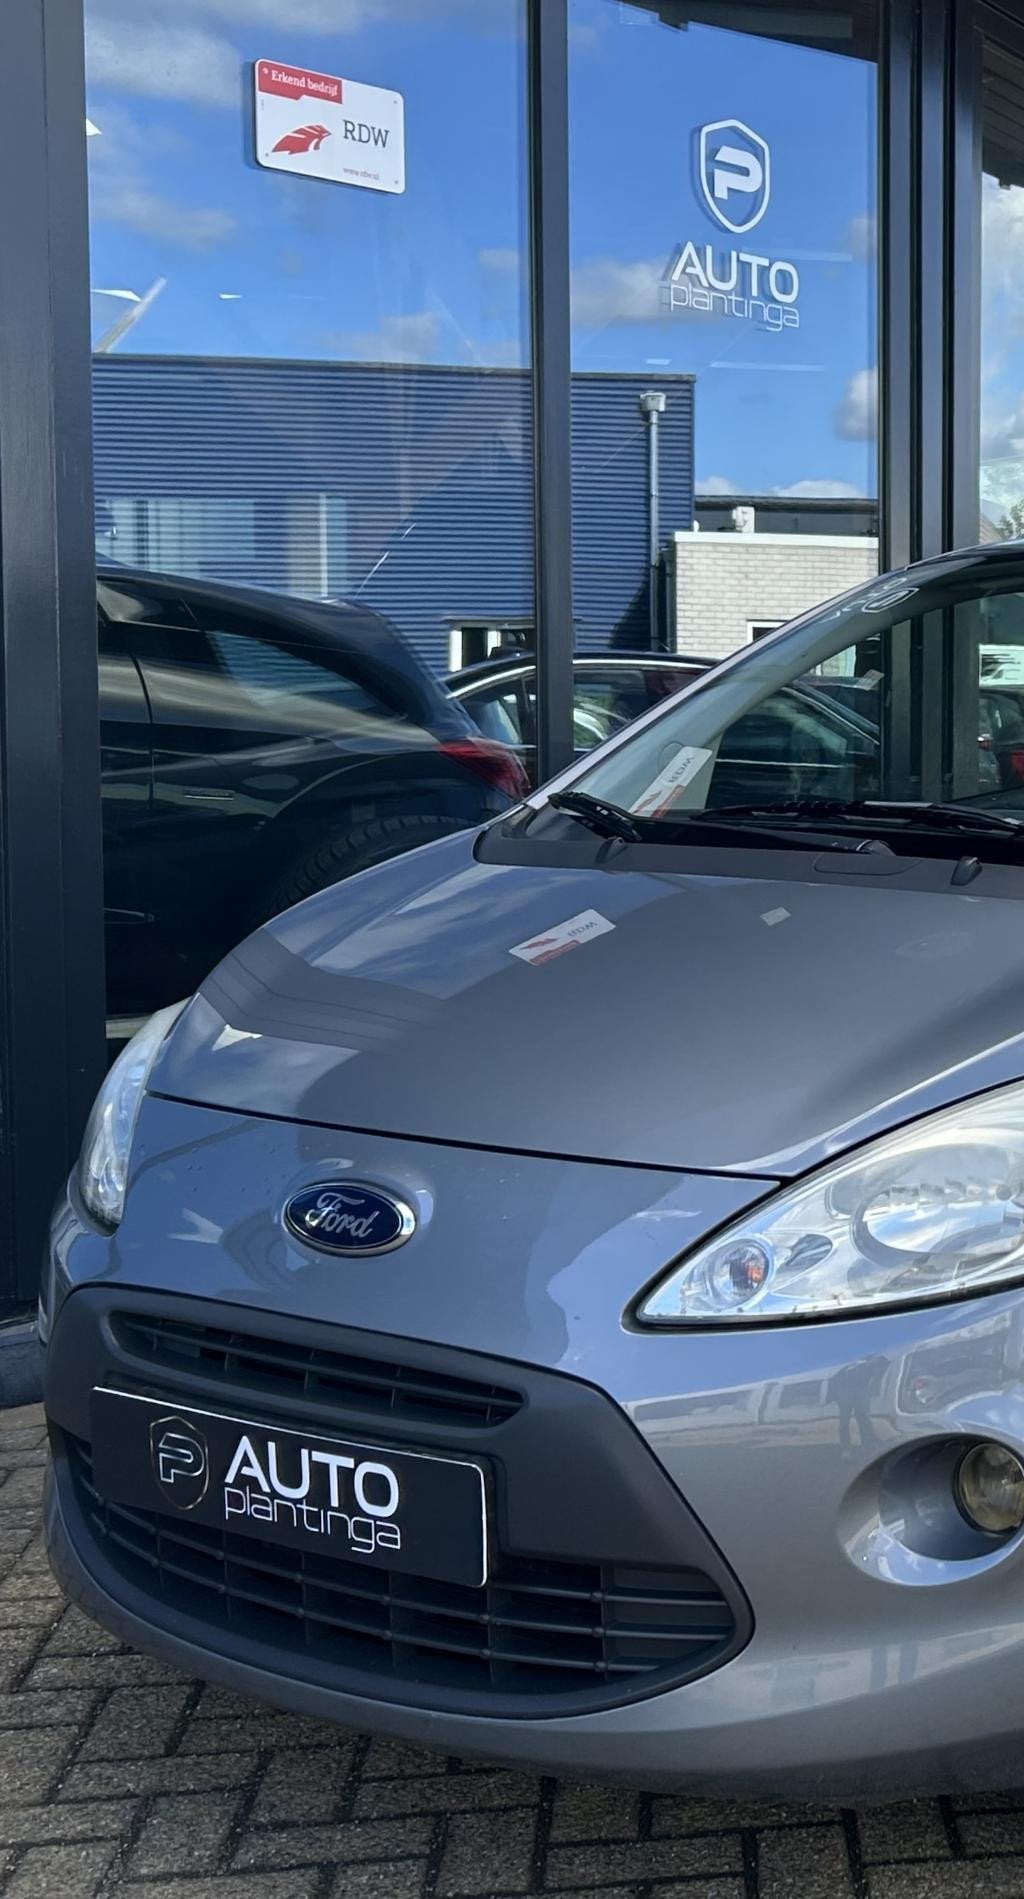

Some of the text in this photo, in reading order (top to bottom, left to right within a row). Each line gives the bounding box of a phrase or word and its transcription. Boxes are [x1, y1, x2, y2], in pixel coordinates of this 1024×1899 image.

[271, 69, 339, 97] Erkend bedrijf
[342, 119, 390, 149] RDW
[670, 240, 800, 304] AUTO
[670, 281, 800, 333] plantinga
[304, 1191, 380, 1239] Ford
[224, 1435, 399, 1518] AUTO
[224, 1485, 400, 1554] plantinga
